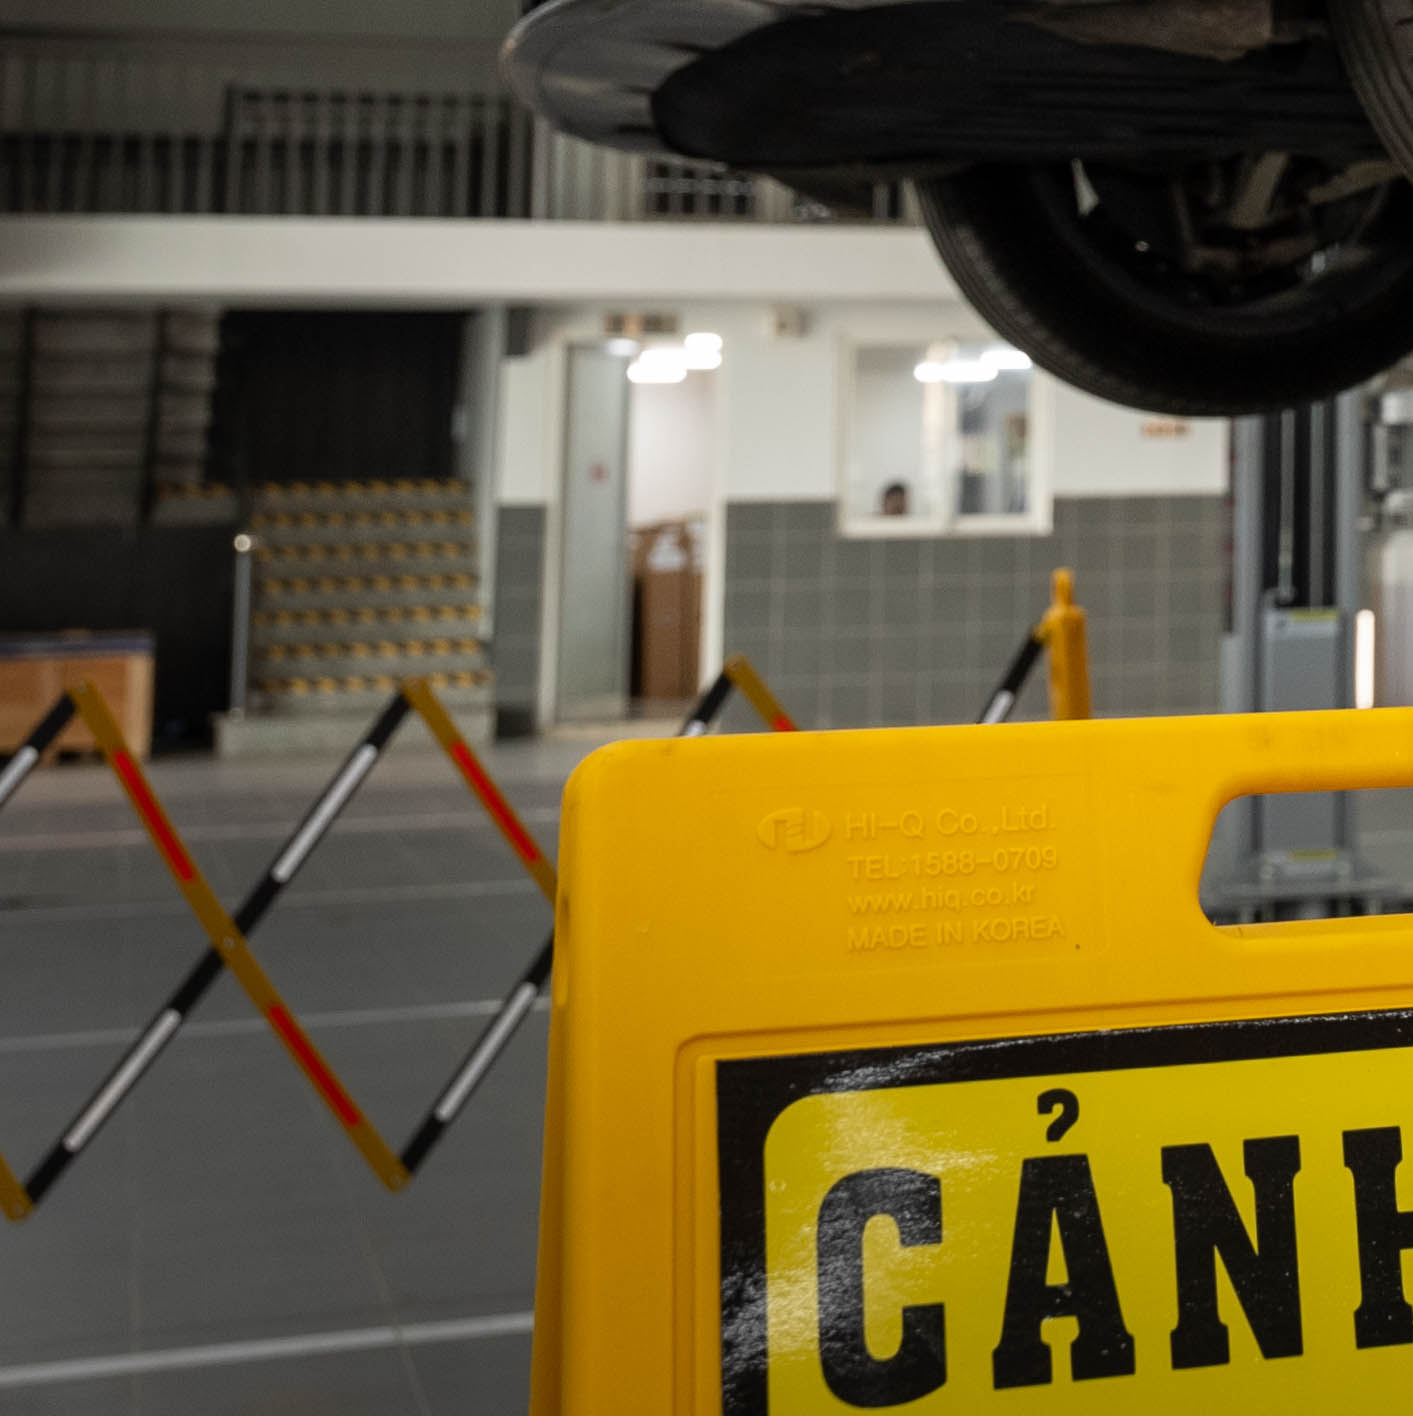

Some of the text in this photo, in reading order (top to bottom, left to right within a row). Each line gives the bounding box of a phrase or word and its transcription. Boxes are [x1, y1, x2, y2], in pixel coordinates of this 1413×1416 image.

[846, 882, 1035, 914] www.hiq.co.kr
[847, 914, 1064, 952] MADE IN KOREA
